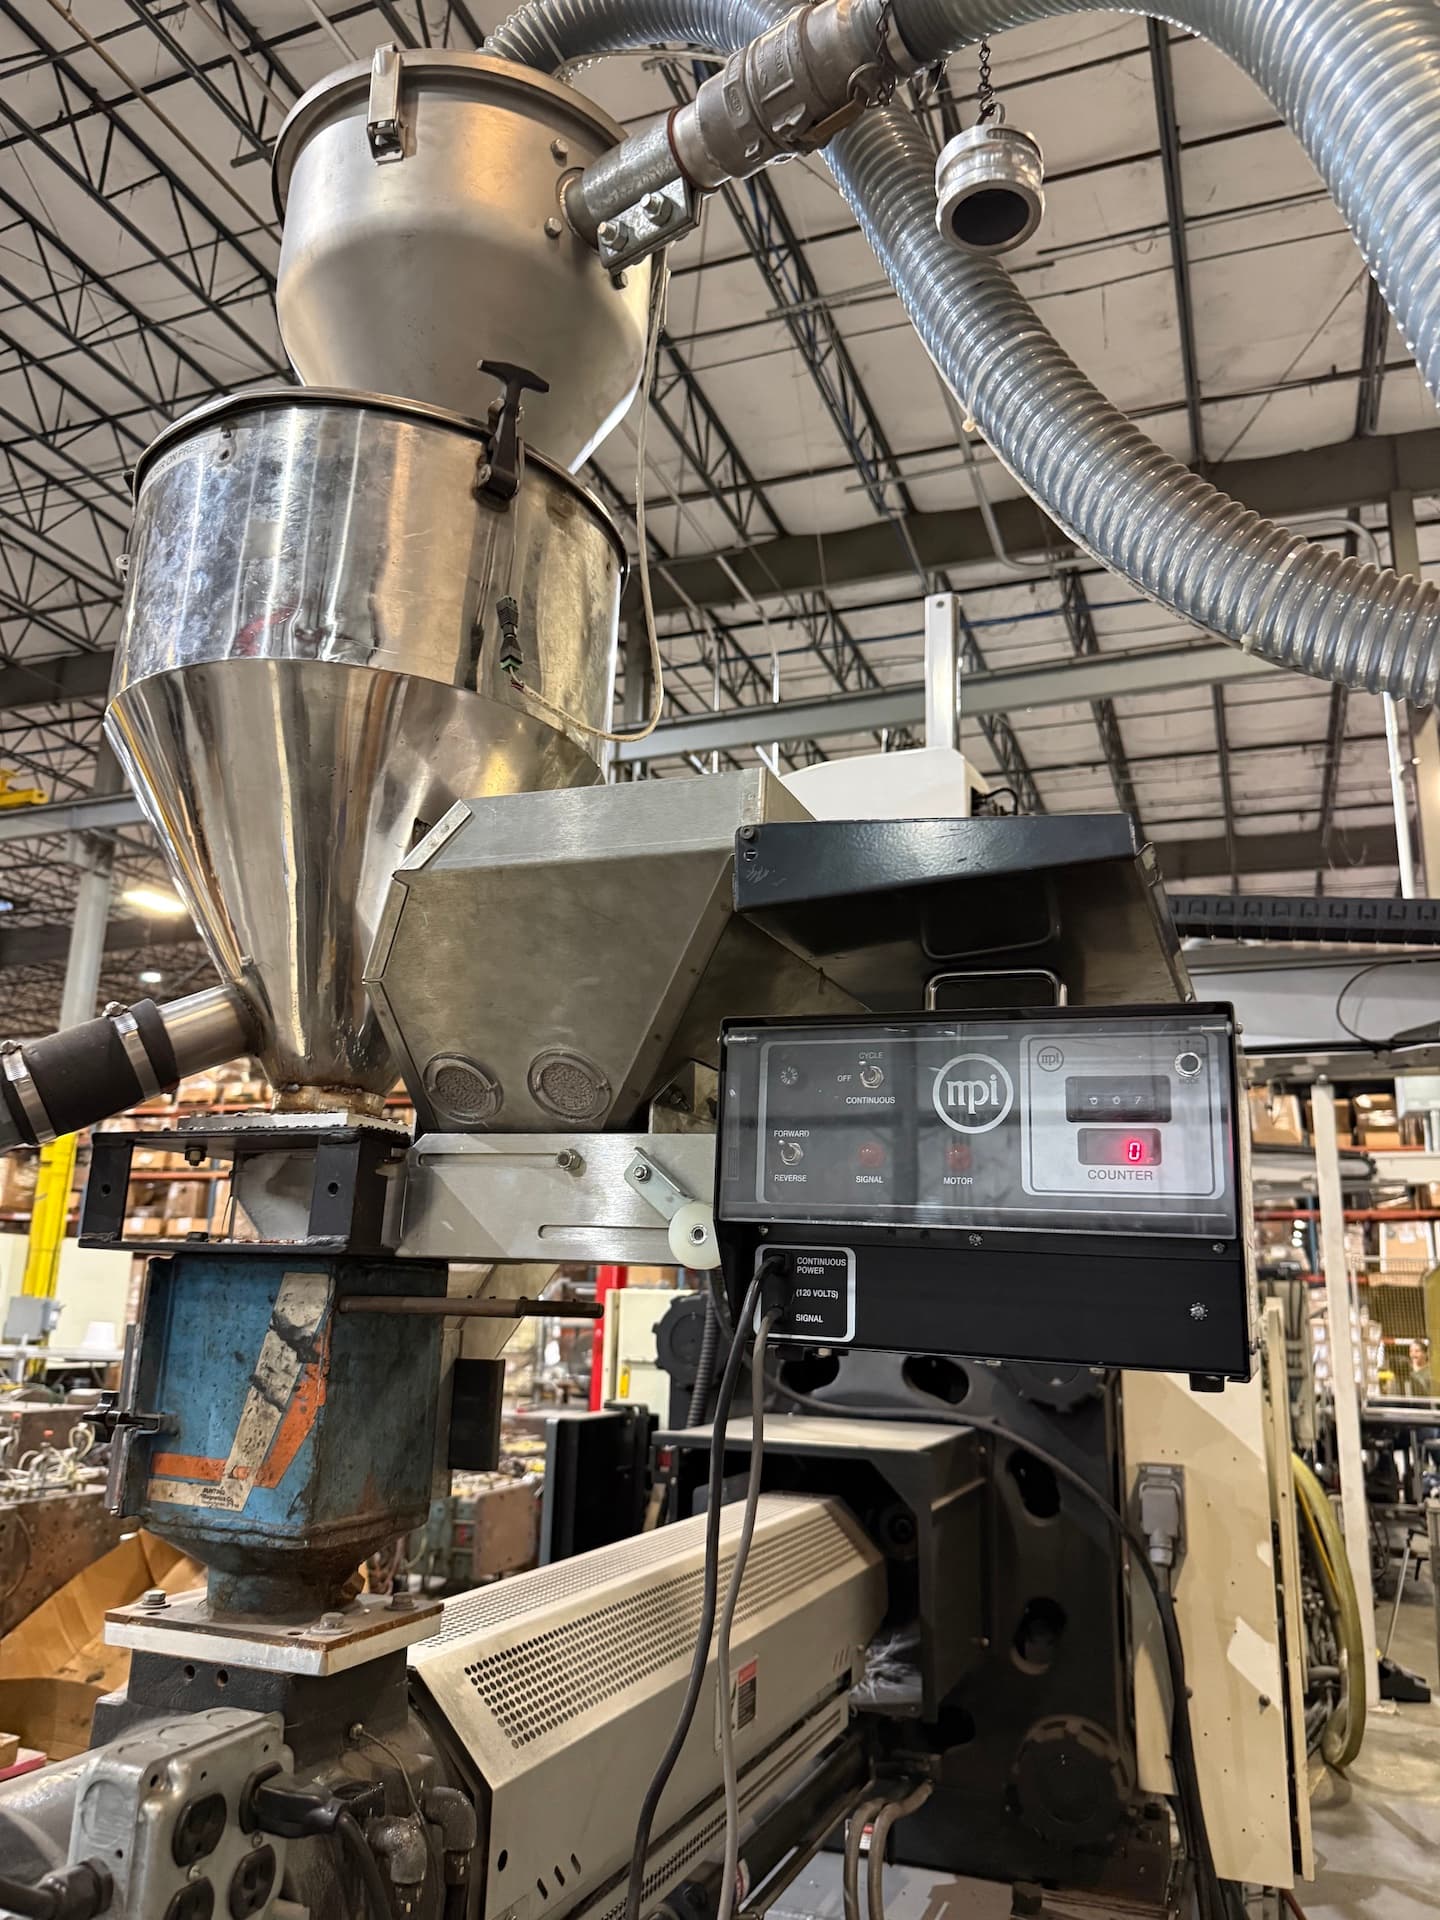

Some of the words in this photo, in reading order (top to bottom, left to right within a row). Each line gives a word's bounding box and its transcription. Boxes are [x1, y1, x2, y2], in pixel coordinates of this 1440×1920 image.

[946, 1073, 1000, 1115] mpi
[846, 1096, 896, 1104] CONTINUOUS
[774, 1174, 807, 1182] REVERSE
[855, 1175, 884, 1183] SIGNAL
[1087, 1169, 1153, 1181] COUNTER
[943, 1177, 973, 1185] MOTOR
[796, 1256, 847, 1267] CONTINUOUS
[796, 1266, 825, 1275] POWER
[795, 1288, 812, 1298] (120
[812, 1289, 839, 1300] VOLTS)
[795, 1313, 824, 1323] SIGNAL
